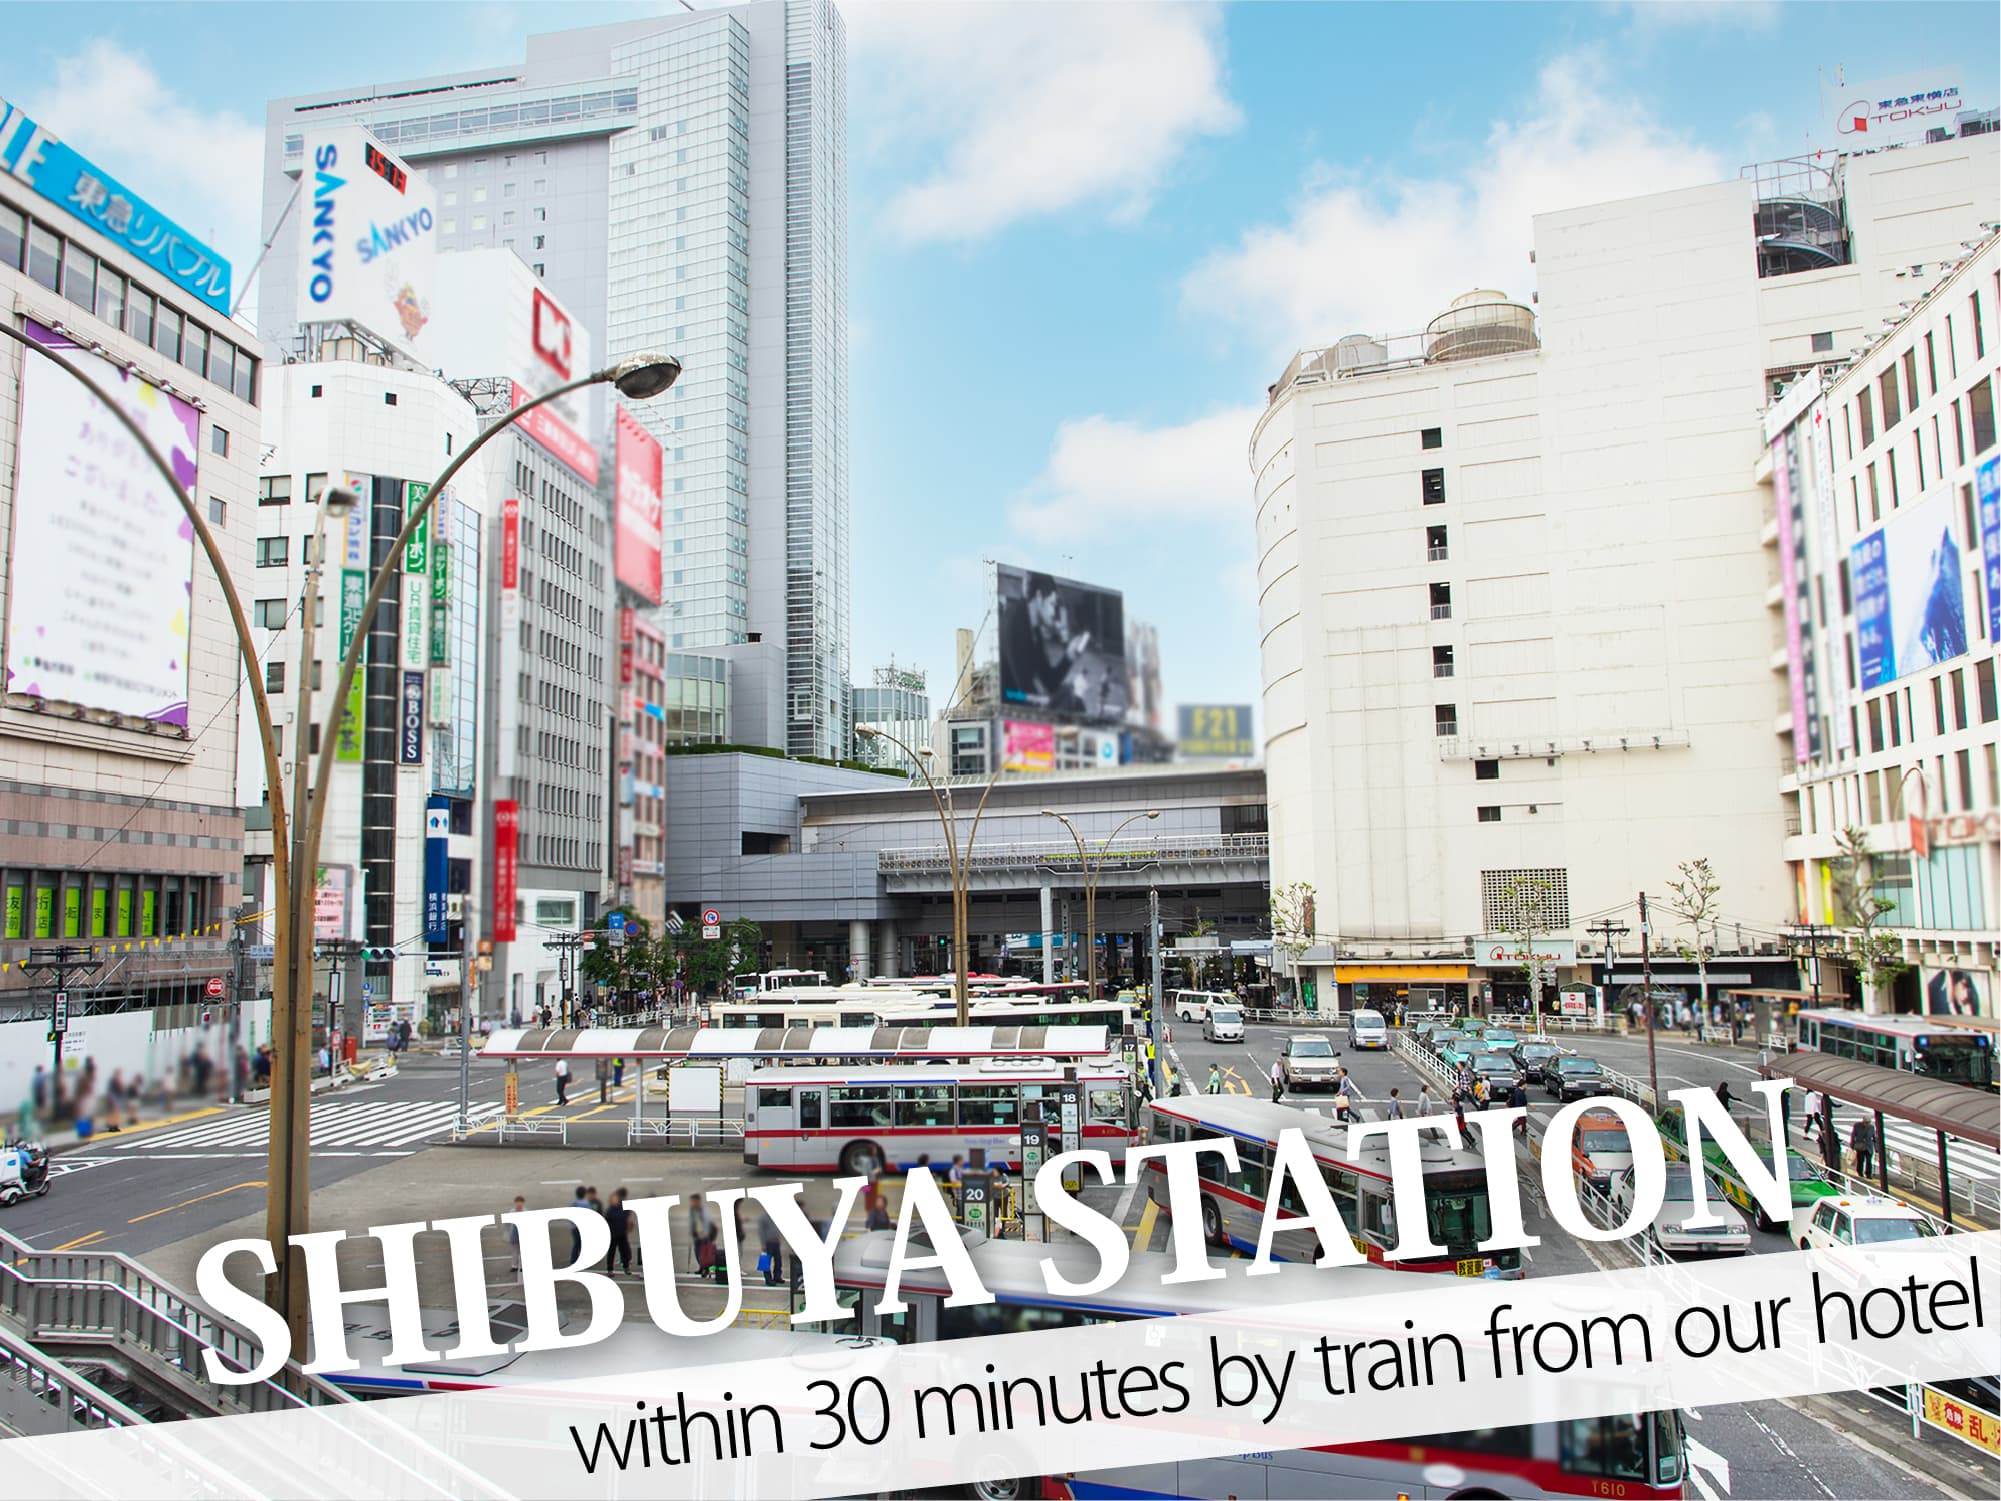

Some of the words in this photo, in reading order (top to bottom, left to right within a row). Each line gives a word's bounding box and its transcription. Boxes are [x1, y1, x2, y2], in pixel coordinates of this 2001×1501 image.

[1870, 99, 1962, 123] TOKYU
[1878, 87, 1959, 110] 東急東横店
[68, 171, 226, 297] 東急リバブル
[310, 143, 347, 304] SANKYO
[356, 207, 433, 263] SANKYO
[406, 701, 420, 759] BOSS
[1194, 708, 1237, 737] F21
[428, 893, 438, 931] 横浜銀行
[1062, 1093, 1077, 1103] 18
[1023, 1134, 1040, 1145] 19
[966, 1188, 984, 1200] 20
[1592, 1480, 1625, 1497] T610
